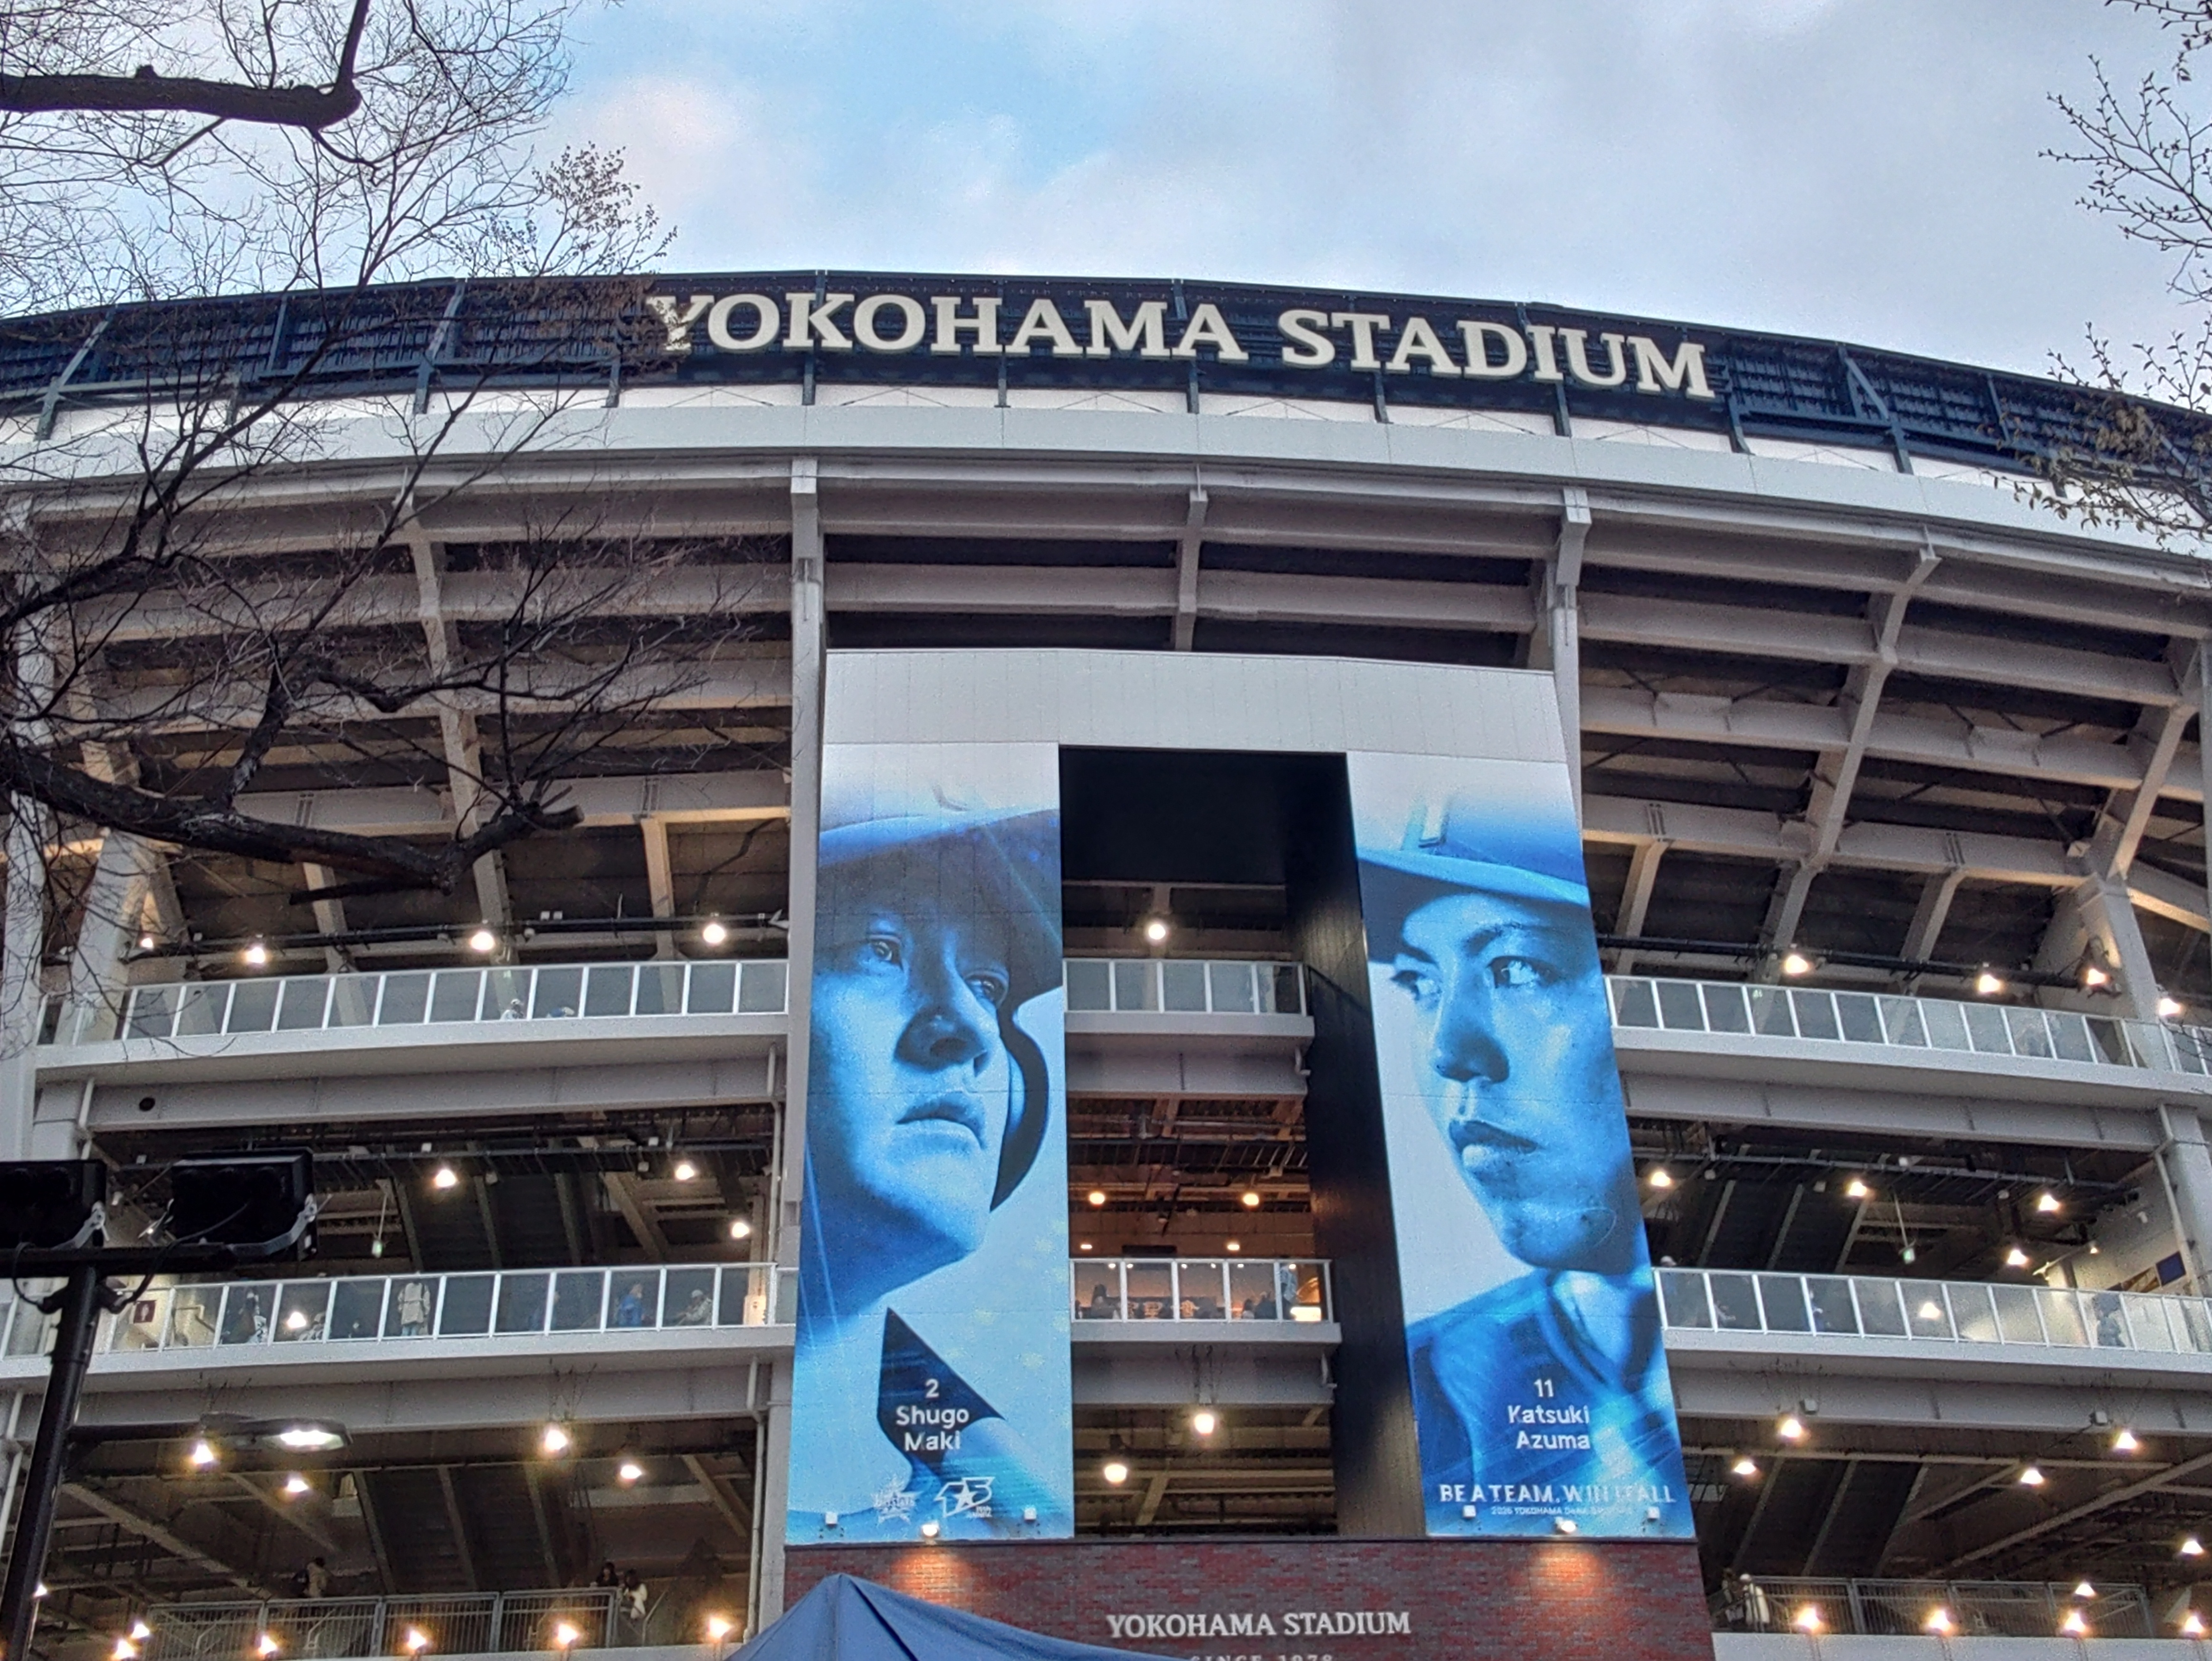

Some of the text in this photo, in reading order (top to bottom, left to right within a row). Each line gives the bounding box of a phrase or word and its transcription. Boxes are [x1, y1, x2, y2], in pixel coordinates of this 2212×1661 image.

[645, 292, 1716, 399] YOKOHAMA STADIUM
[925, 1378, 939, 1398] 2
[1534, 1379, 1554, 1398] 11
[896, 1405, 970, 1428] Shugo
[1508, 1404, 1590, 1424] Katsuki
[905, 1430, 961, 1451] Maki
[1516, 1430, 1591, 1450] Azuma
[1439, 1484, 1465, 1502] BE
[1470, 1484, 1487, 1502] A
[1488, 1484, 1561, 1503] TEAM.
[1107, 1611, 1412, 1638] YOKOHAMA STADIUM
